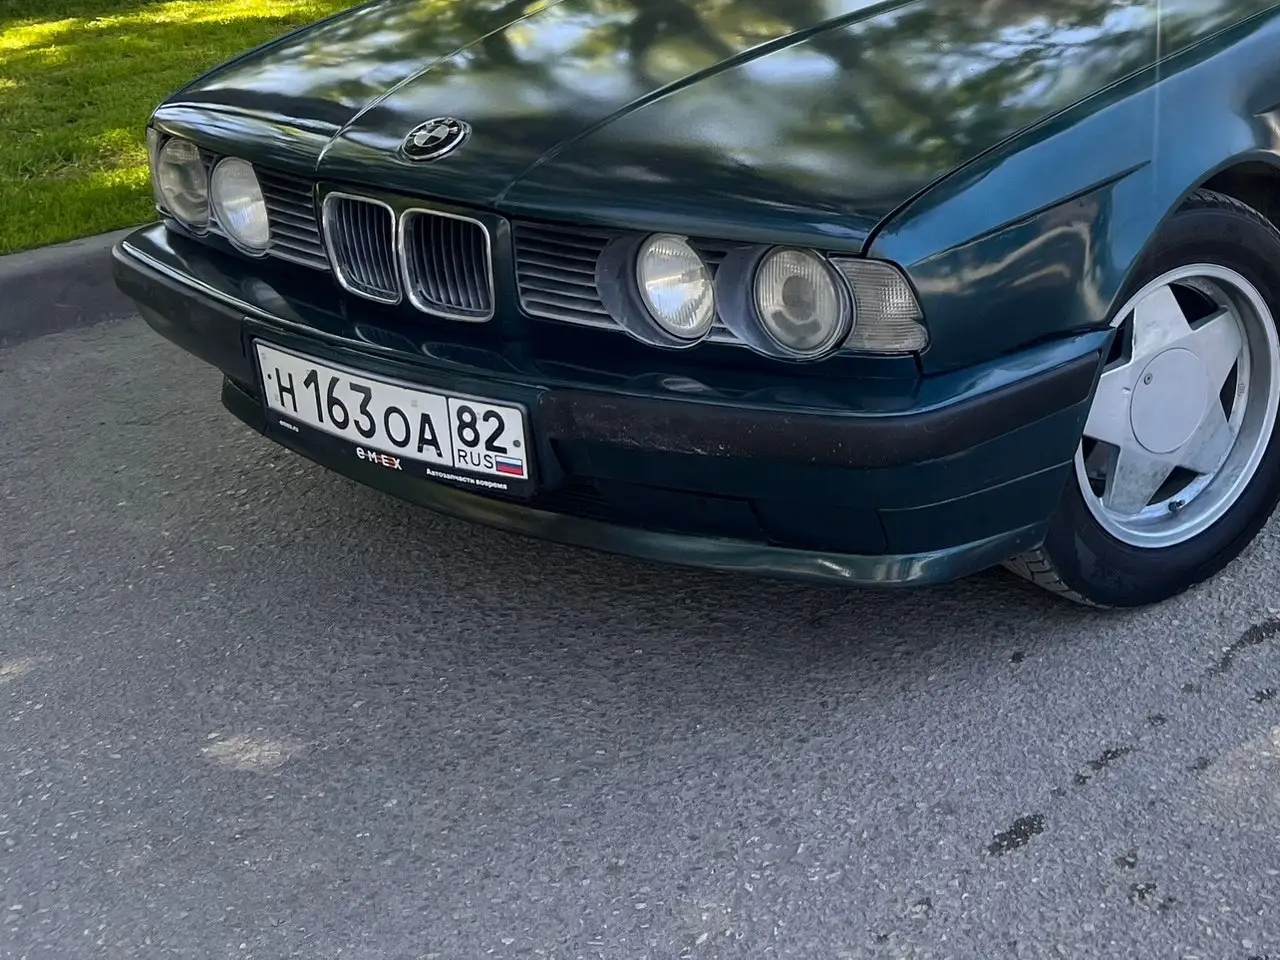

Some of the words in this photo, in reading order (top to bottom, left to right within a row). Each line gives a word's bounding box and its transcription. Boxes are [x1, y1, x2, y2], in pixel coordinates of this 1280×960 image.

[455, 404, 508, 455] 82
[457, 449, 494, 470] RUS
[426, 468, 475, 484] Автозапчасти
